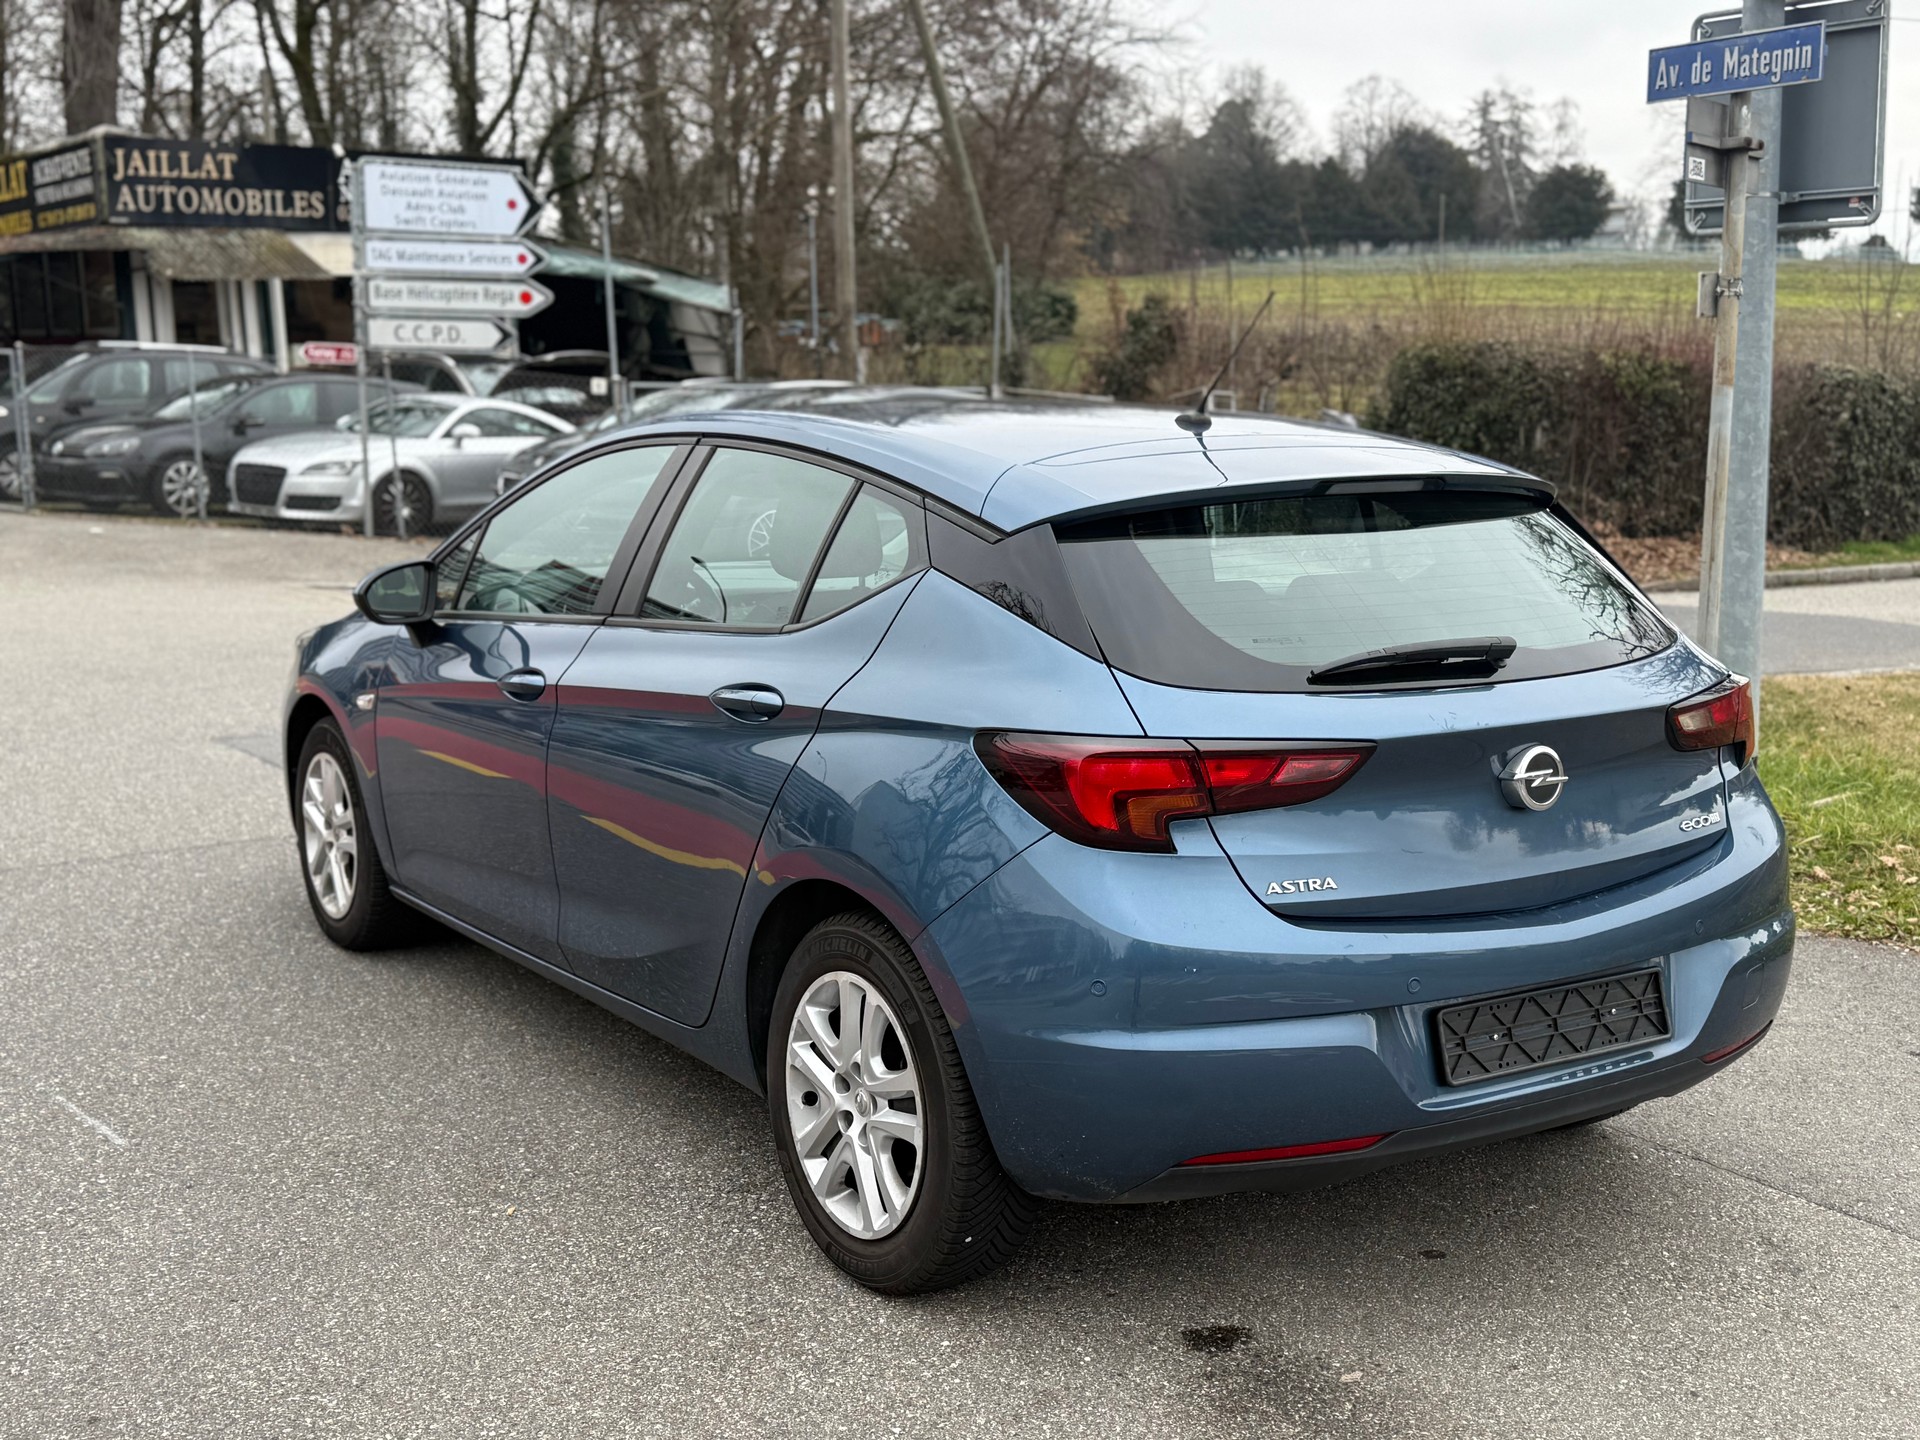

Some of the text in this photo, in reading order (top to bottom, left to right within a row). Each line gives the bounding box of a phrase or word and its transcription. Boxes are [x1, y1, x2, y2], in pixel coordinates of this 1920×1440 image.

[1655, 40, 1813, 90] Av. de Mategnin
[113, 148, 239, 181] JAILLAT
[379, 169, 431, 182] Aviation
[115, 184, 326, 219] AUTOMOBILES
[438, 188, 488, 201] Aviation
[396, 249, 465, 263] Maintenance
[373, 283, 403, 300] Base
[393, 323, 467, 344] C.C.P.D.
[1265, 876, 1338, 896] ASTRA
